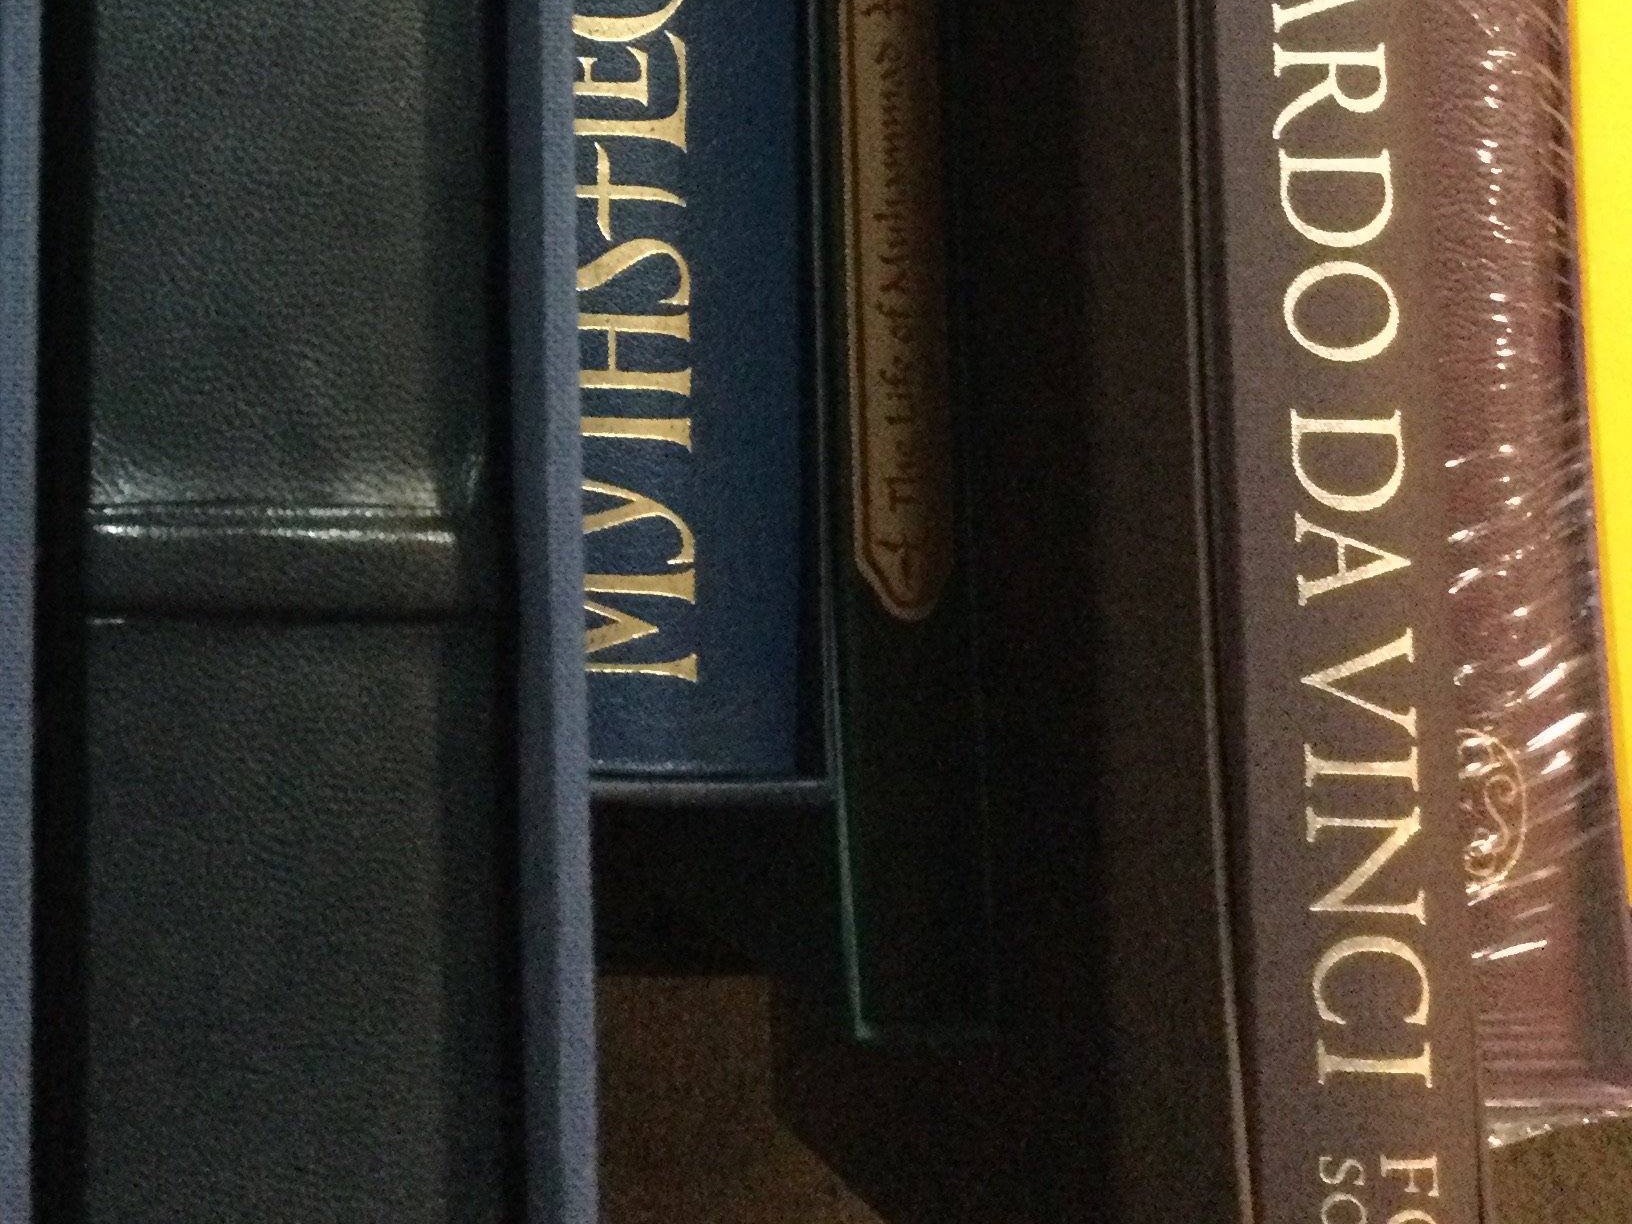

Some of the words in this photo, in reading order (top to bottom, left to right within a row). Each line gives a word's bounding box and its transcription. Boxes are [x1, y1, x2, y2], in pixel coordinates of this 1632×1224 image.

[1289, 407, 1412, 607] DA
[1299, 627, 1434, 1089] VINCI
[1379, 1152, 1440, 1224] F
